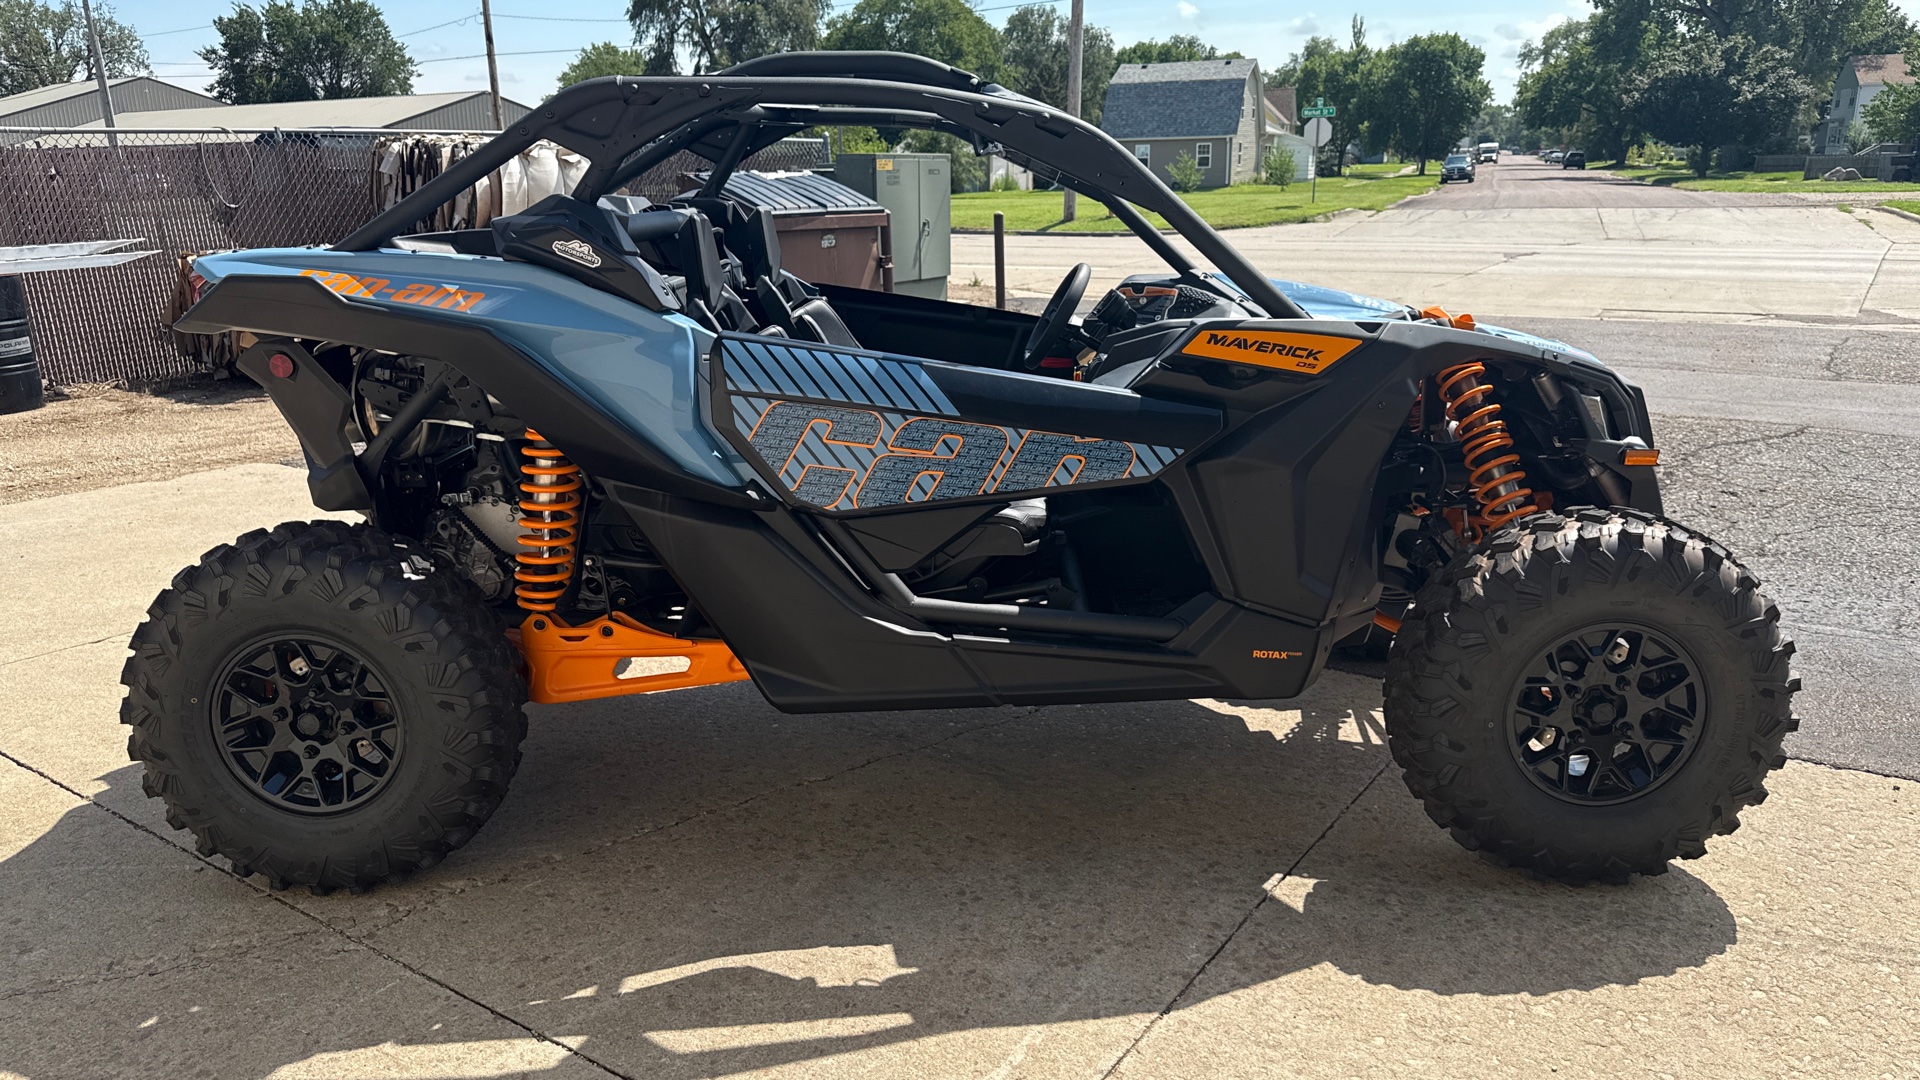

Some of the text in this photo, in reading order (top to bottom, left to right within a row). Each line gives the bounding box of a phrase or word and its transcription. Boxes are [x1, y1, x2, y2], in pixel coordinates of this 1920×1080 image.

[554, 243, 599, 264] MOTORSPORTS
[1206, 333, 1325, 362] MAVERICK
[1524, 339, 1566, 352] TURBO
[1295, 361, 1319, 370] DS
[1253, 650, 1288, 659] ROTAX
